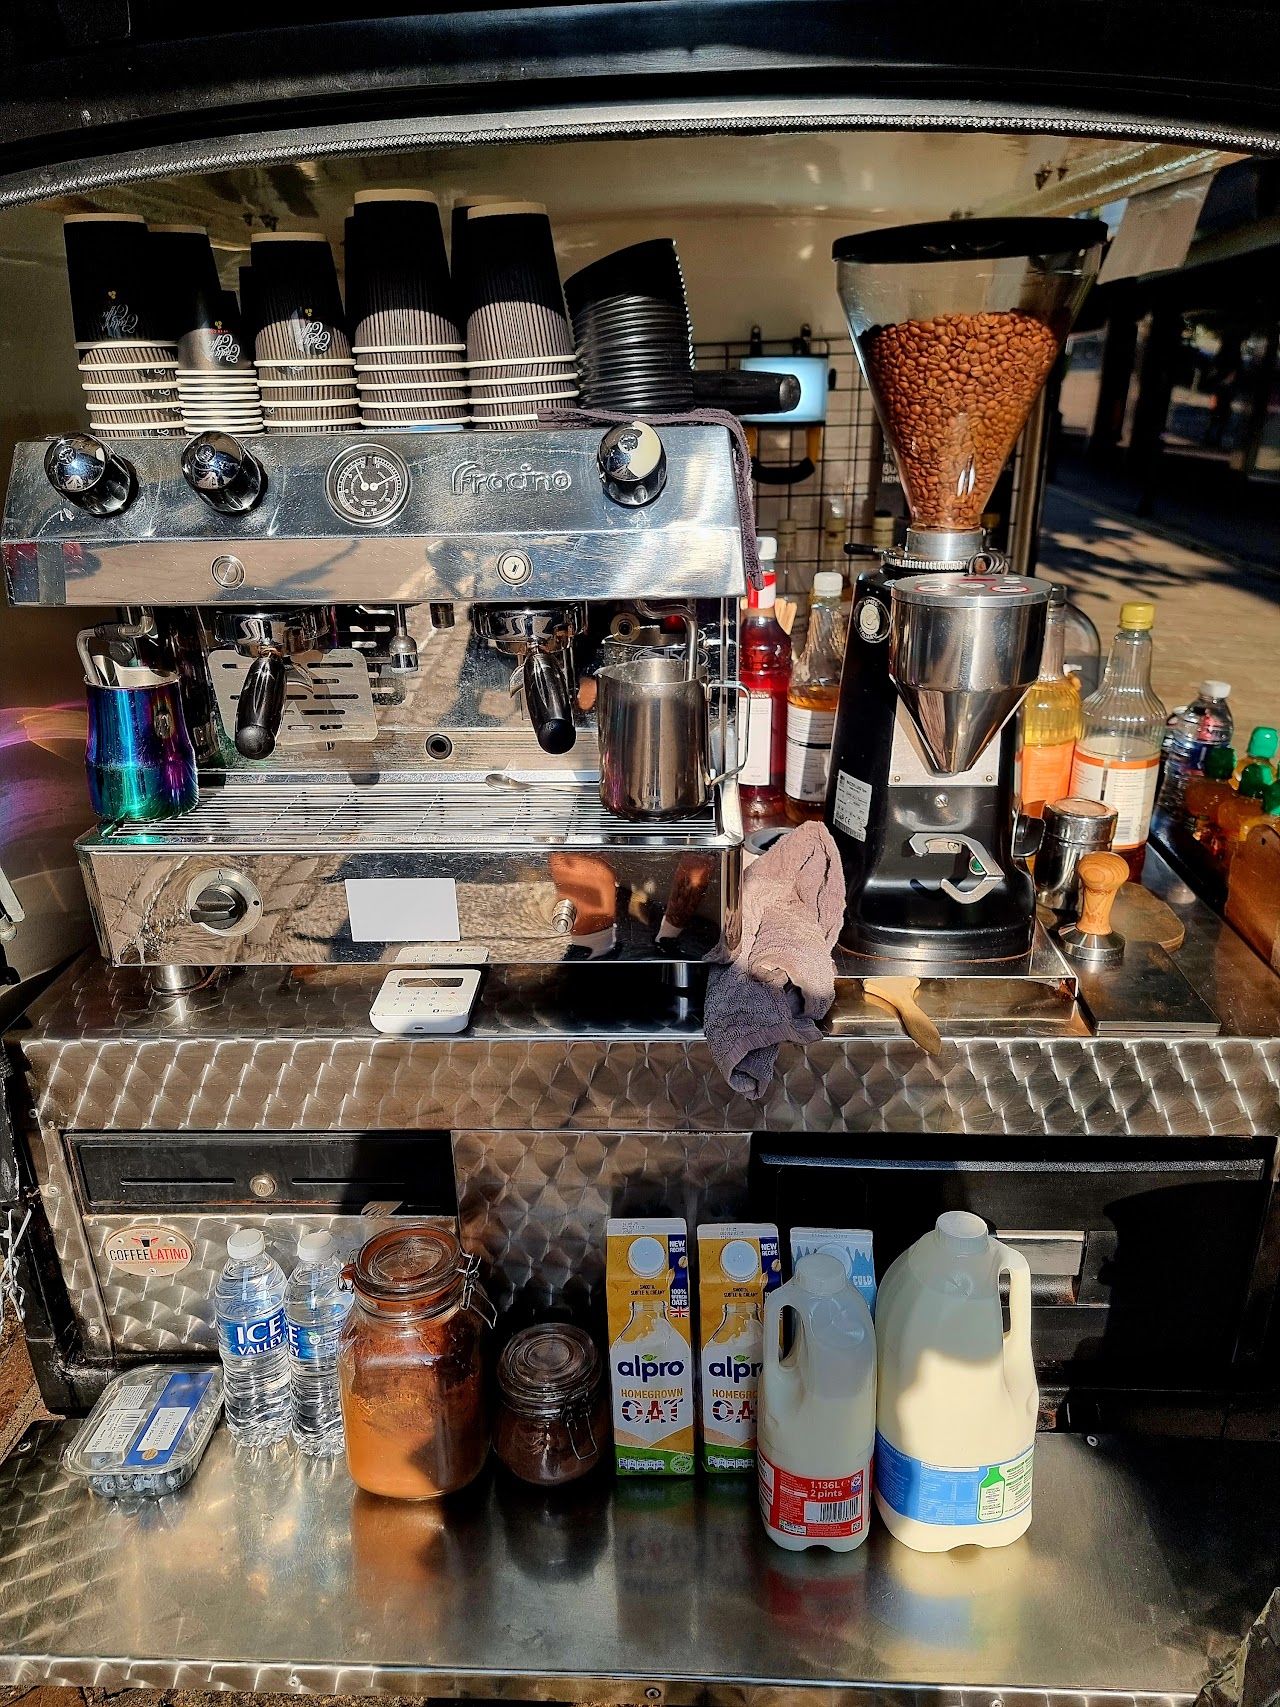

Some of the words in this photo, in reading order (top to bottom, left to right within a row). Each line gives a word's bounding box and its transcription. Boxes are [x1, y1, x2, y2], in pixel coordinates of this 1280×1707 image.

[452, 460, 572, 494] Fracino
[237, 1314, 281, 1345] ICE
[237, 1333, 283, 1356] VALLEY
[617, 1354, 685, 1383] alpro
[708, 1355, 763, 1384] alpr
[621, 1387, 683, 1399] HOMEGROWN
[712, 1388, 757, 1399] HOMEGRO
[621, 1398, 684, 1424] OAT
[712, 1399, 757, 1424] OA
[810, 1480, 840, 1489] 1.136L
[810, 1489, 816, 1497] 2
[817, 1489, 843, 1499] pints
